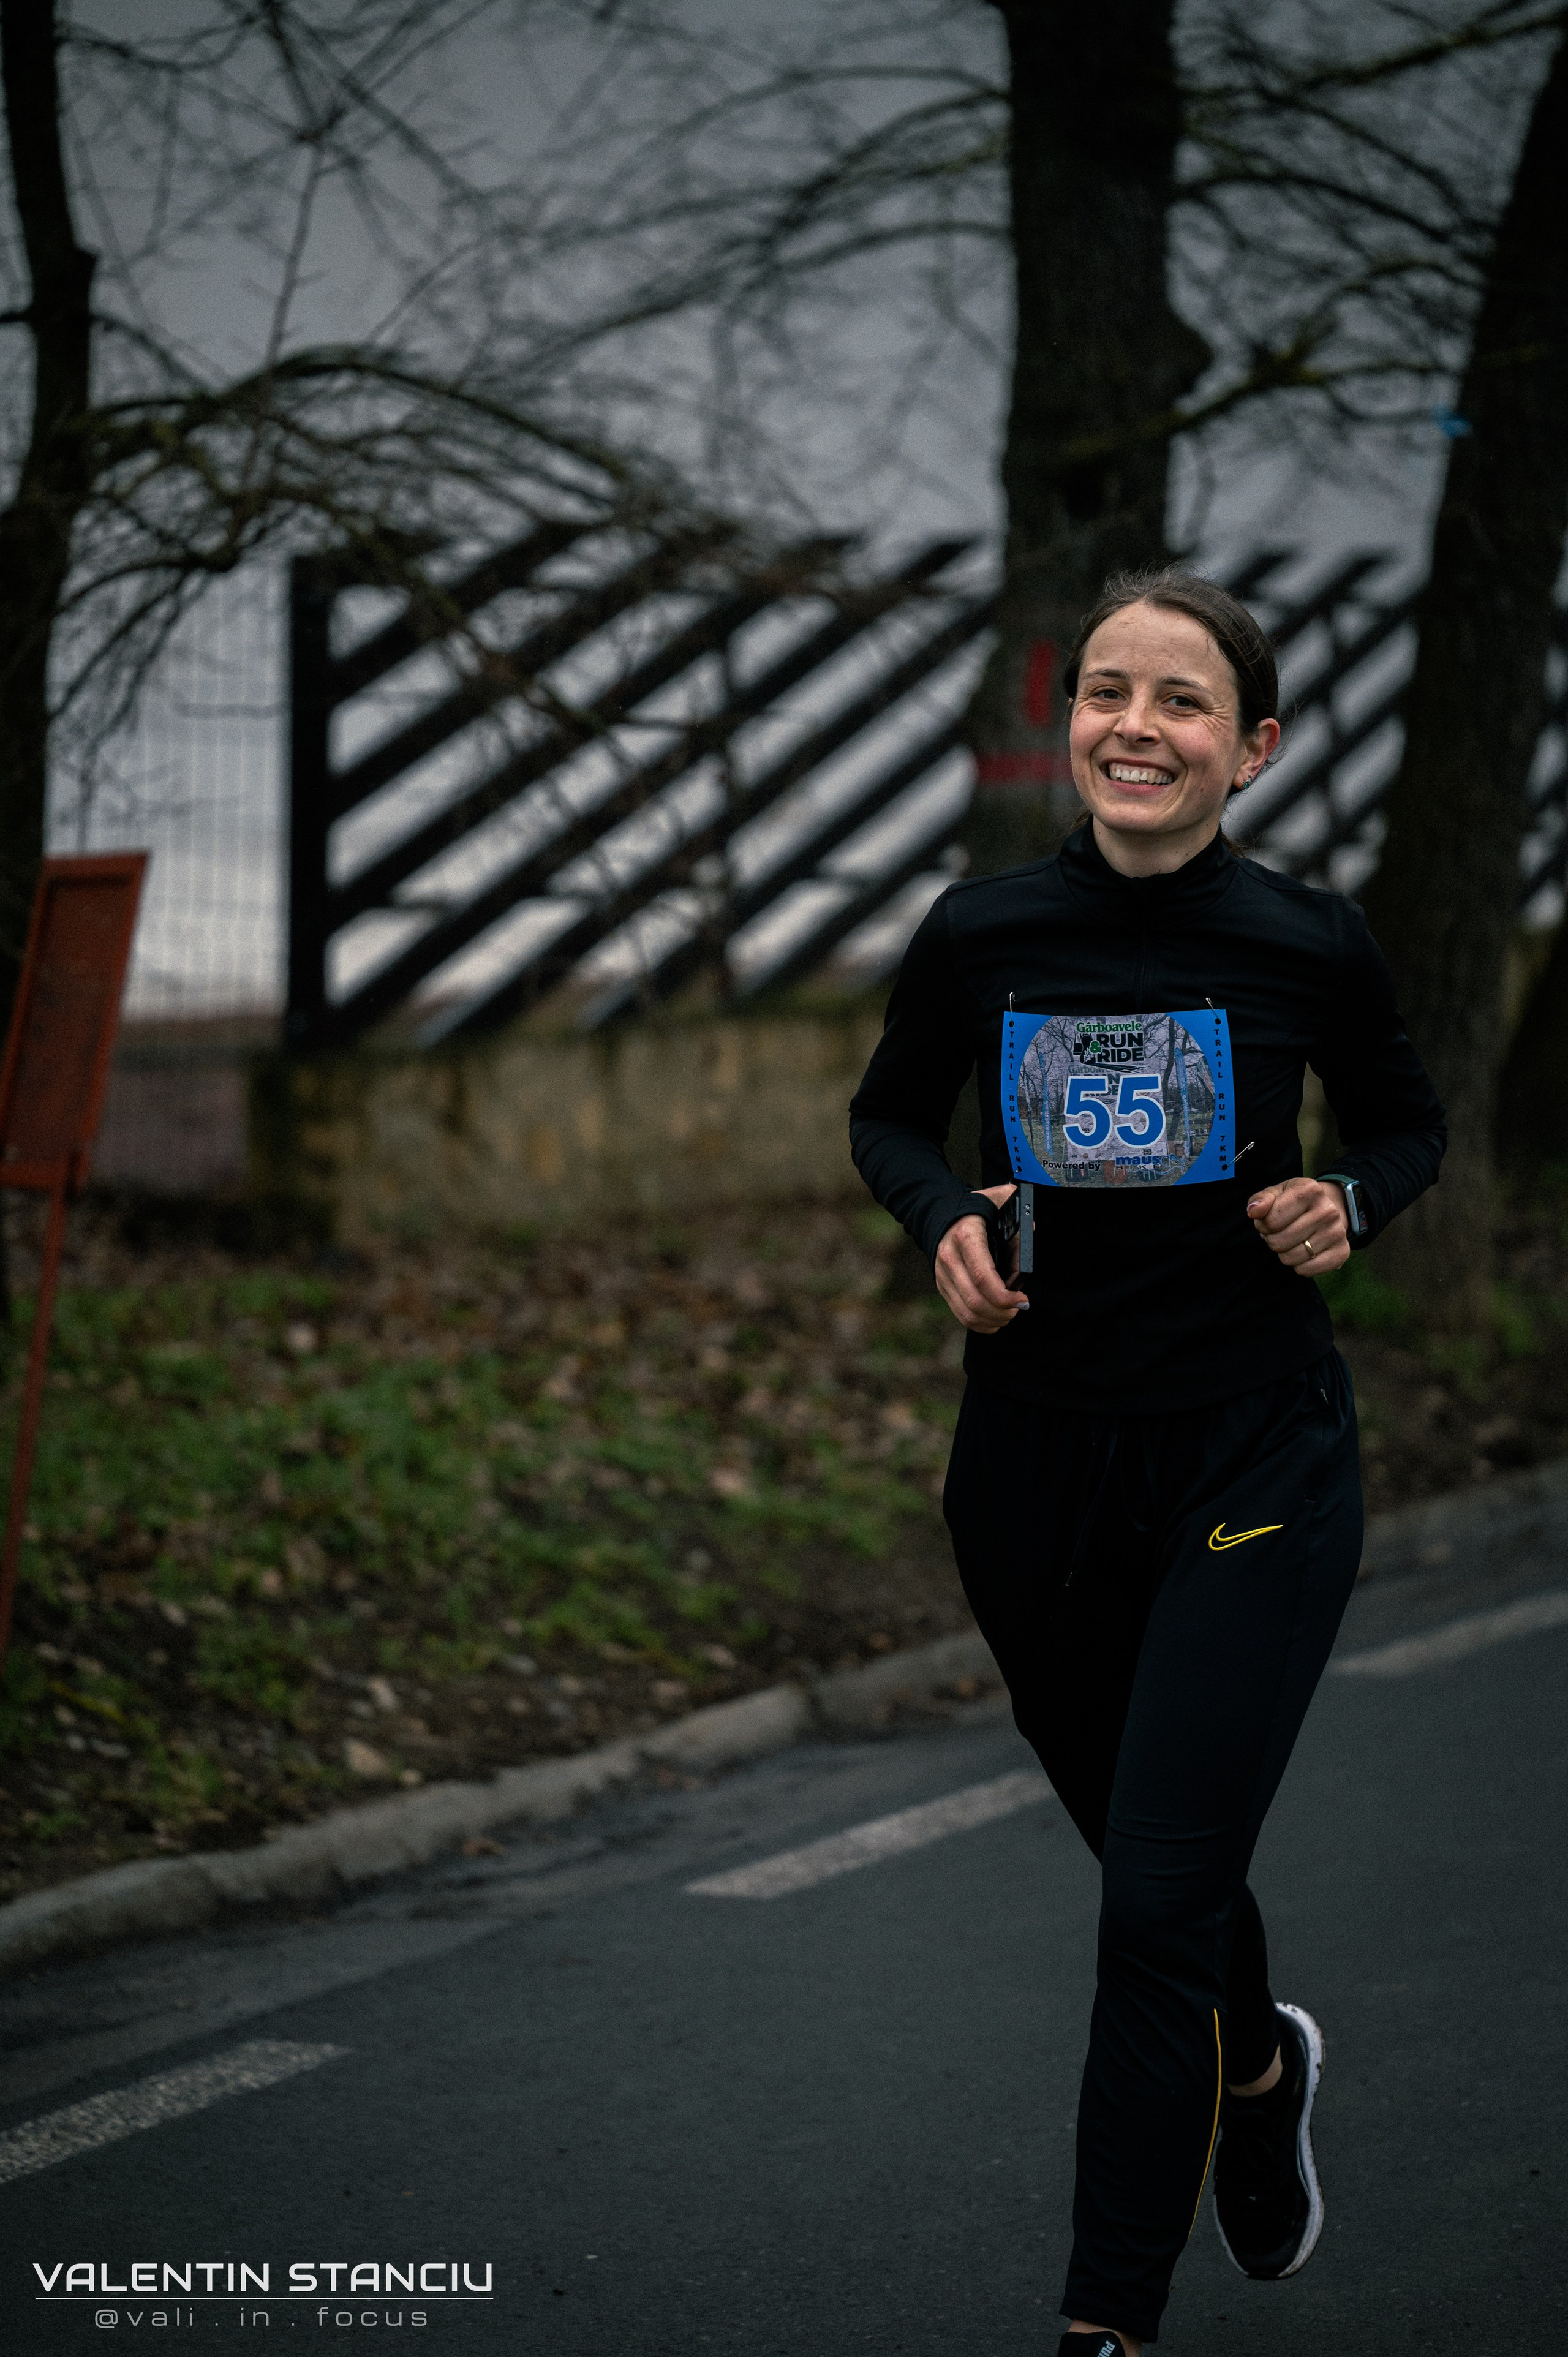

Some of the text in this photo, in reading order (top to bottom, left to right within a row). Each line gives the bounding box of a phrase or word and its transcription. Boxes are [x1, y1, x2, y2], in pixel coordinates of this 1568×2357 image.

[1076, 1020, 1142, 1033] Gârboavele
[1096, 1033, 1144, 1048] RUN
[1090, 1041, 1145, 1063] & RIDE
[1214, 1029, 1223, 1079] TRAIL
[1063, 1074, 1165, 1148] 55
[1042, 1160, 1101, 1172] Powered by
[1115, 1155, 1160, 1166] maus
[1097, 2340, 1115, 2357] PU
